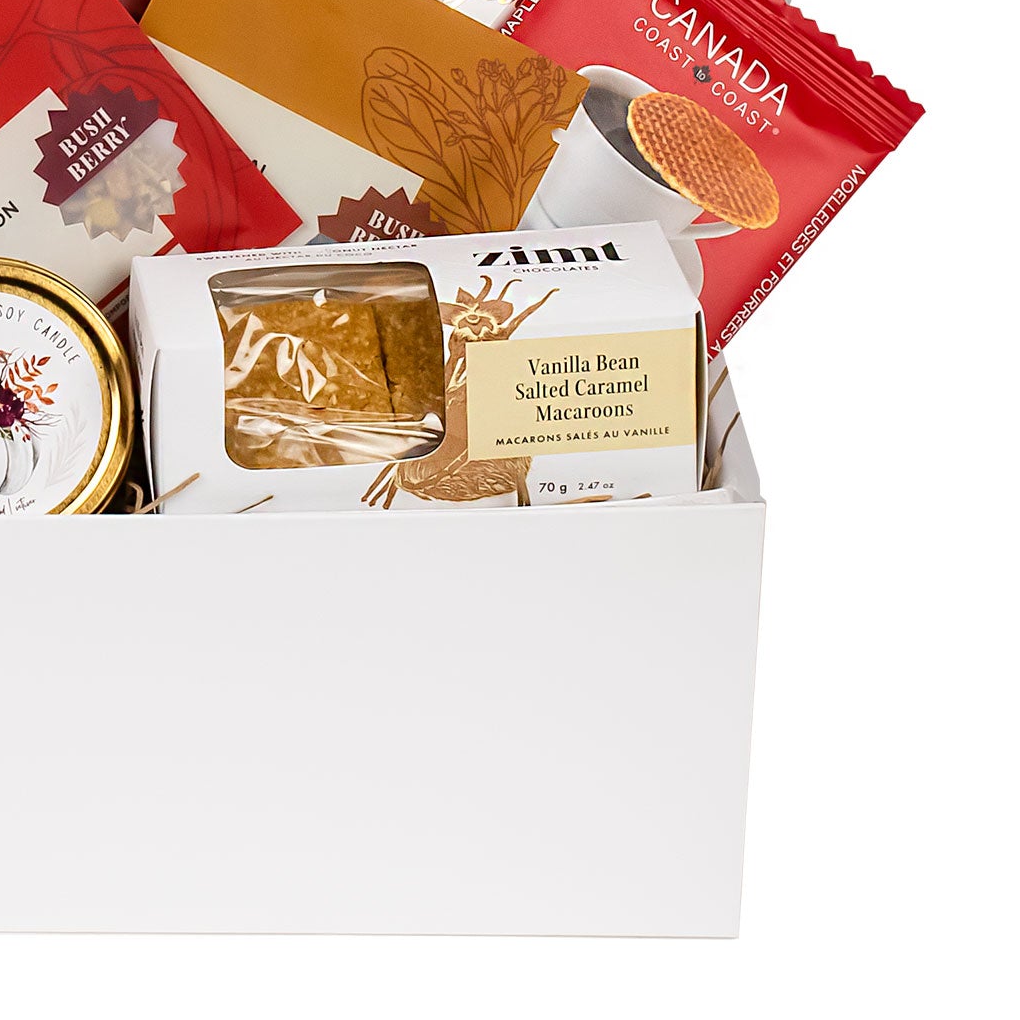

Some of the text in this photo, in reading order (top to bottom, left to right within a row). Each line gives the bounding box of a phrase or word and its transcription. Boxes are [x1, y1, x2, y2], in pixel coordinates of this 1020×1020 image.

[633, 17, 695, 69] COAST
[695, 69, 706, 81] to
[58, 106, 113, 158] BUSH
[66, 116, 130, 182] BERRY
[791, 164, 867, 255] MOELLEUSES
[196, 251, 267, 261] SWEETENED
[271, 249, 302, 257] WITH
[372, 244, 418, 252] NECTAR
[265, 253, 311, 261] NECTAR
[473, 240, 630, 267] zimt
[777, 251, 795, 275] ET
[513, 265, 599, 274] CHOCOLATES
[33, 318, 81, 365] CANDLE
[528, 354, 640, 376] Vanilla Bean
[515, 374, 649, 401] Salted Caramel
[536, 402, 634, 422] Macaroons
[495, 426, 670, 446] MACARONS SALÉS AU VANILLE
[538, 481, 615, 495] 70 g 2.47 oz
